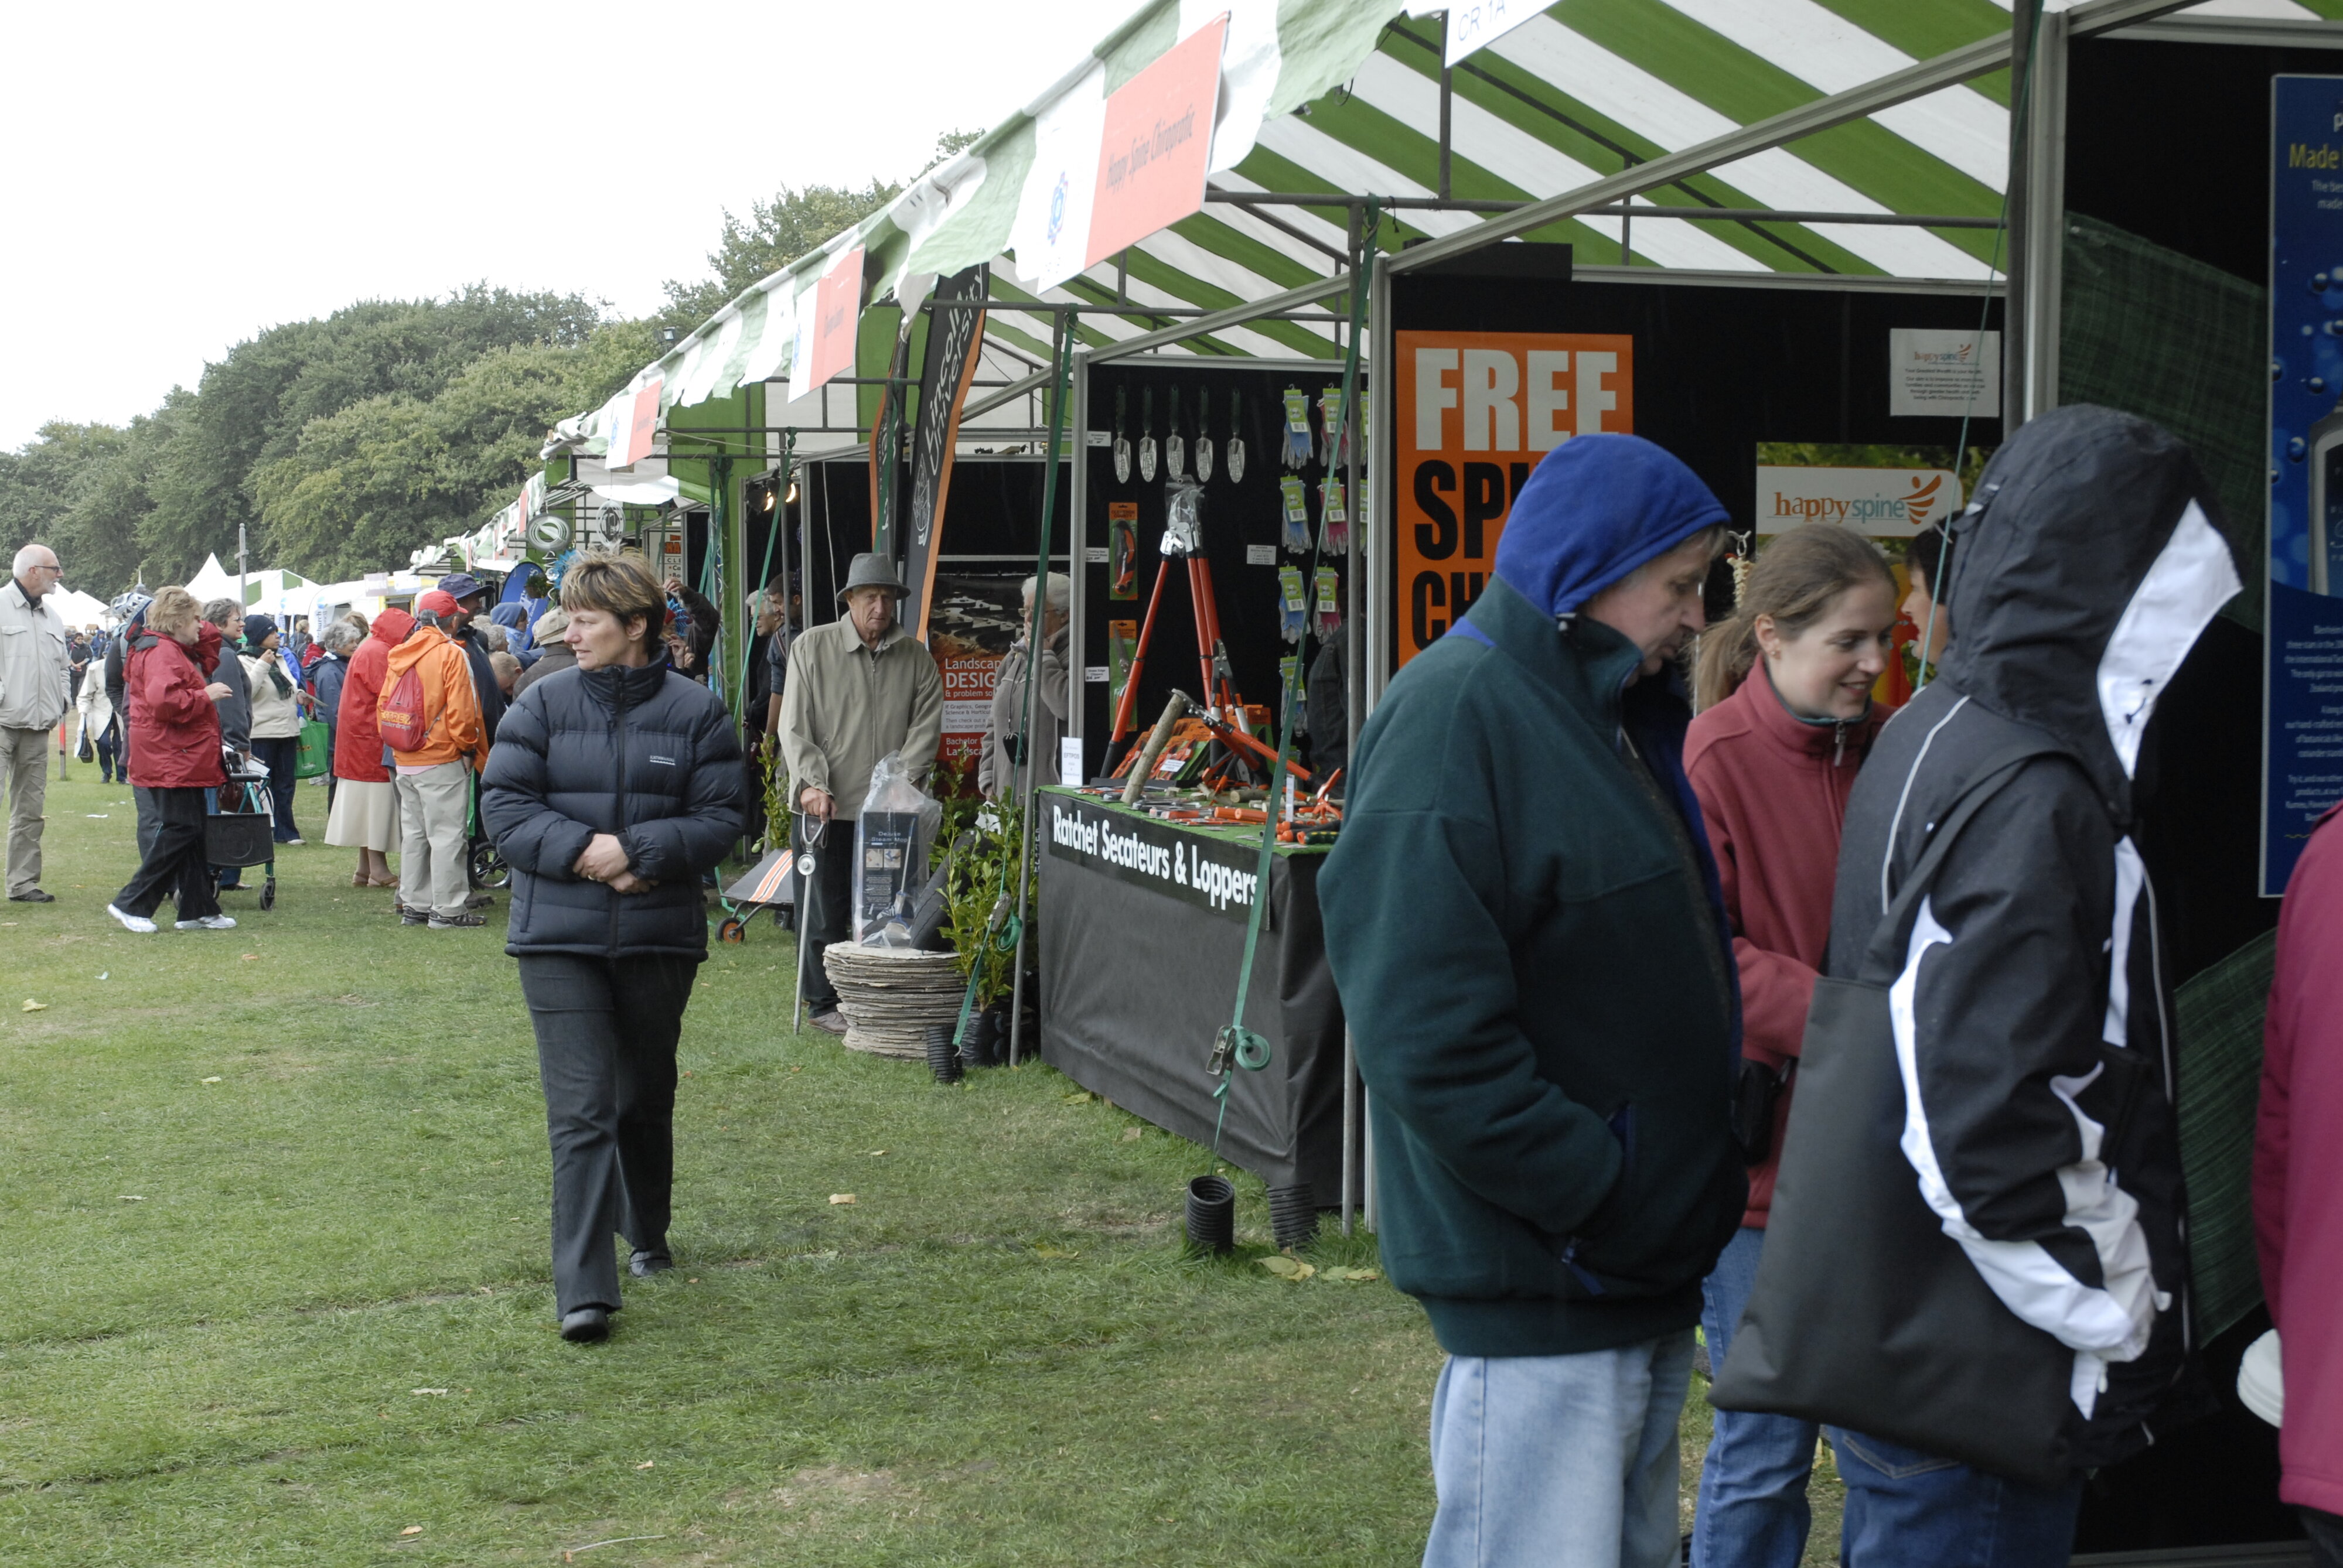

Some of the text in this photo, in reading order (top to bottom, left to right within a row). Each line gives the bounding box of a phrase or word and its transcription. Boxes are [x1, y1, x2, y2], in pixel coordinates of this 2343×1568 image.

[1458, 6, 1481, 41] CR
[1128, 135, 1150, 183] Spine
[2289, 143, 2339, 169] Made
[925, 291, 962, 454] Lincoln
[929, 264, 983, 476] University
[1416, 348, 1619, 451] FREE
[945, 658, 1001, 671] Landscap
[946, 672, 995, 688] DESIG
[953, 690, 983, 699] problem
[1053, 805, 1098, 856] Ratchet
[1101, 819, 1170, 879] Secateurs
[1174, 841, 1188, 885] &
[1192, 845, 1258, 910] Loppers
